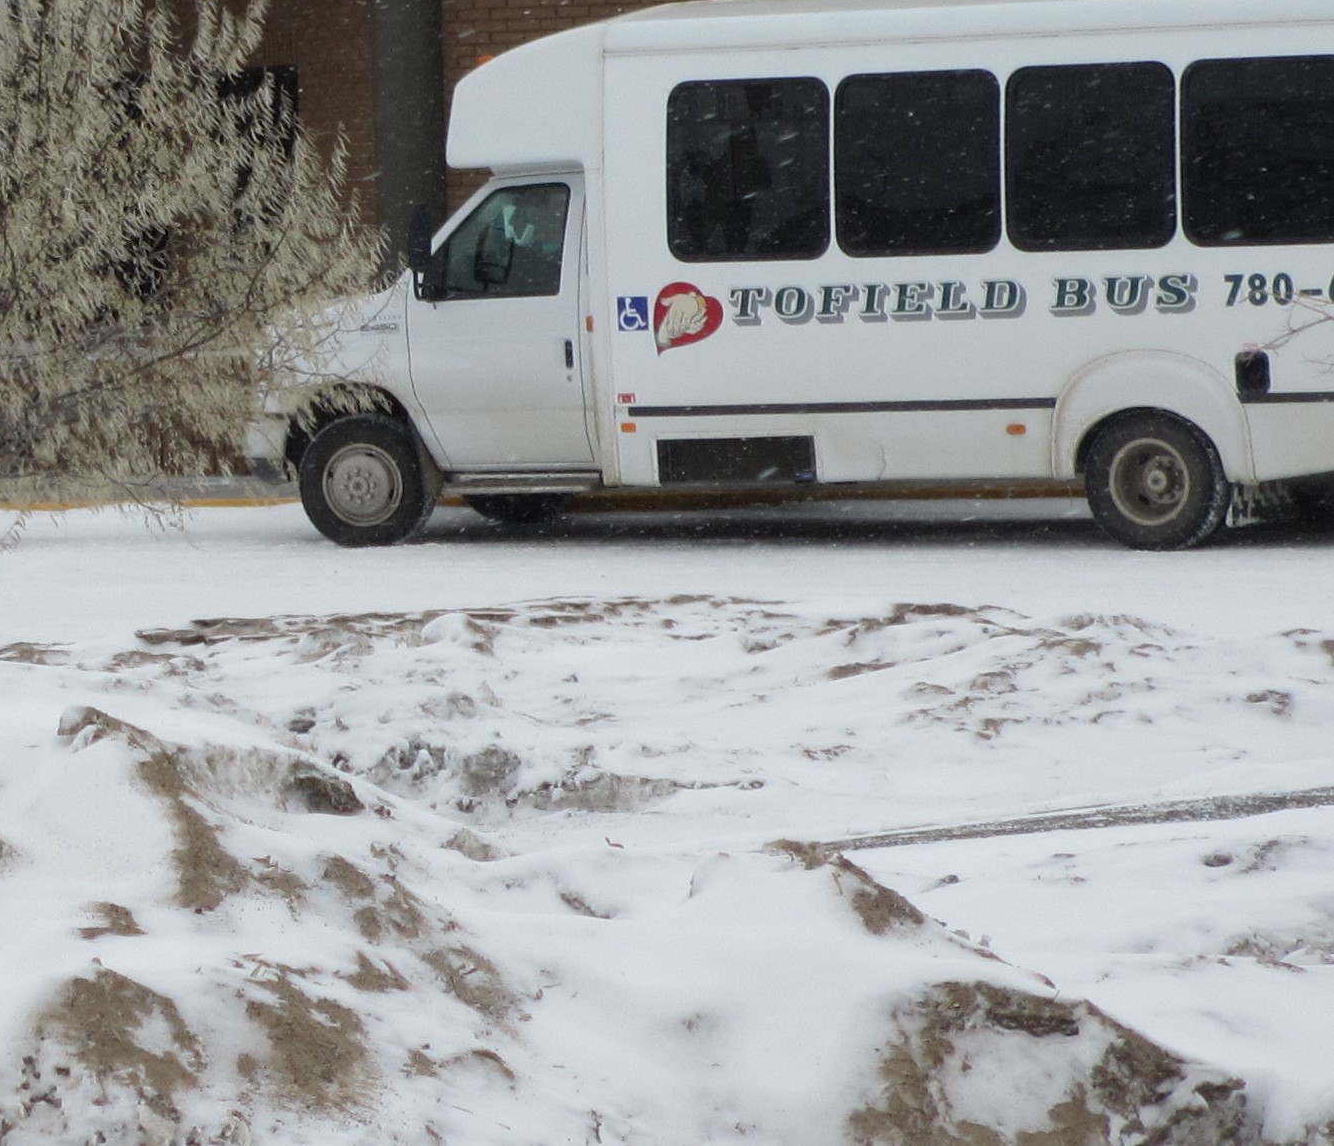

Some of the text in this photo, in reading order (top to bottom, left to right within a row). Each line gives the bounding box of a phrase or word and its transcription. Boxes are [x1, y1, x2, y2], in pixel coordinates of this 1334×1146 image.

[729, 272, 1334, 326] TOFIELD BUS 780-
